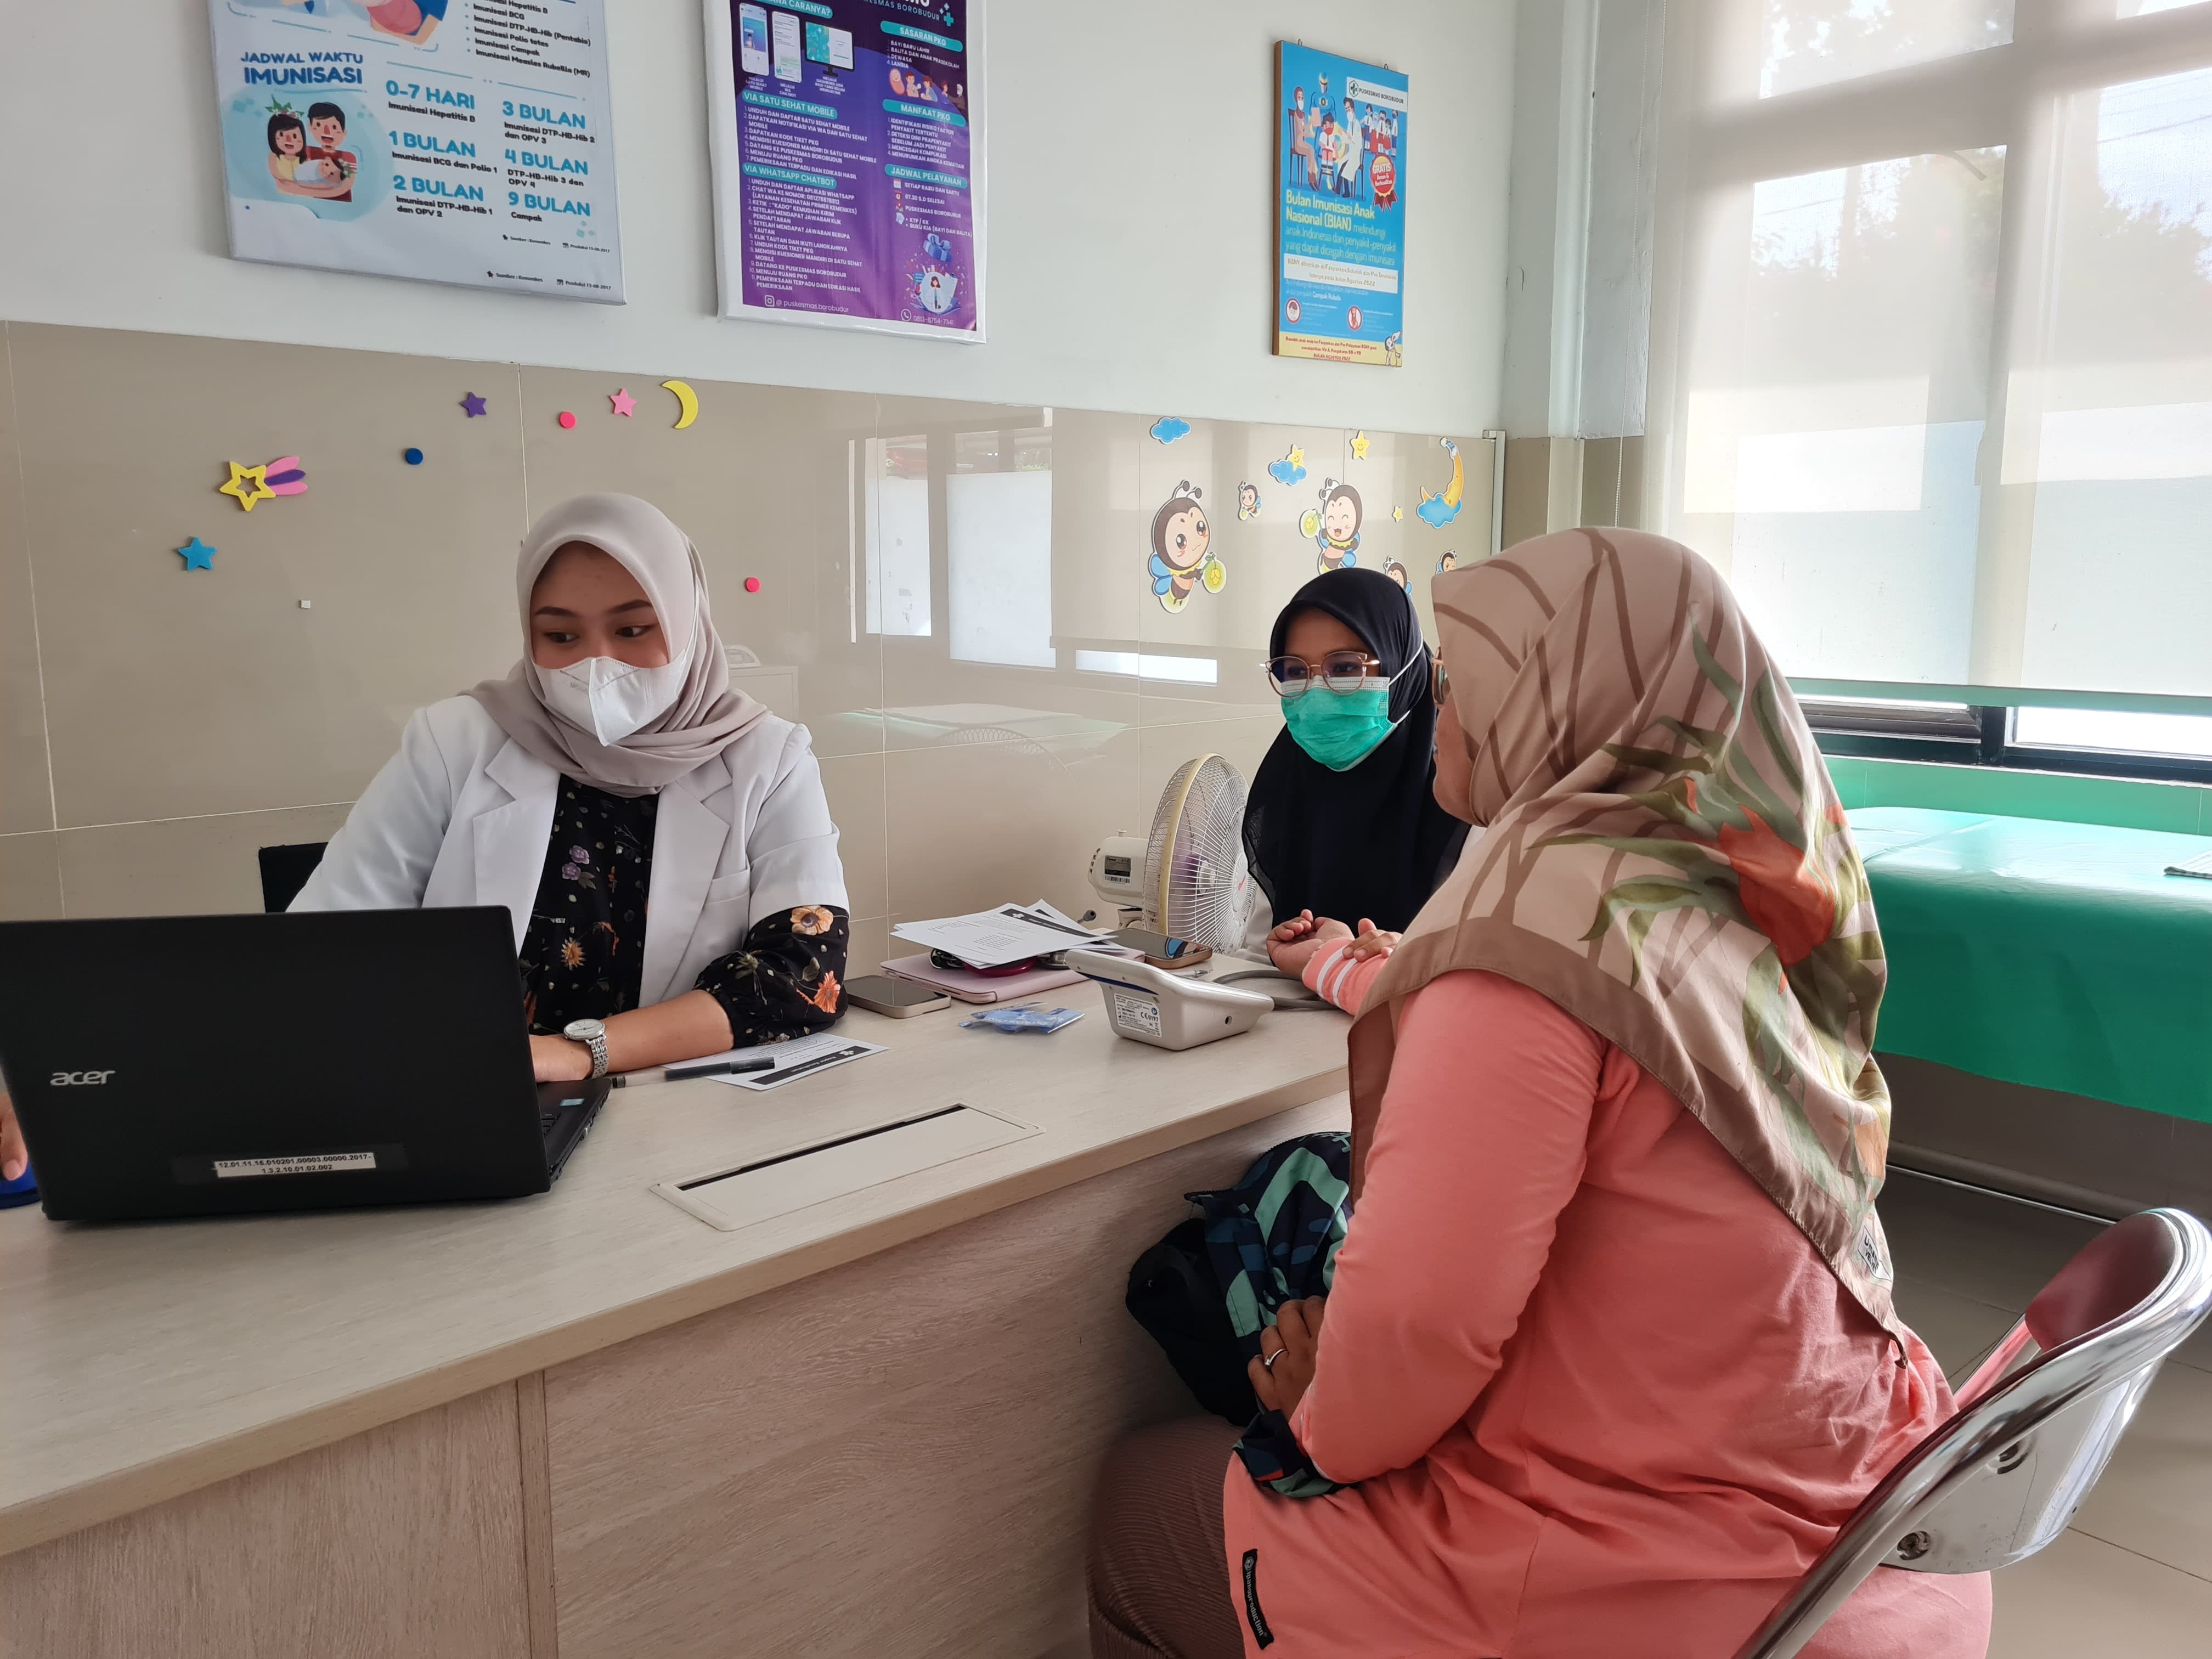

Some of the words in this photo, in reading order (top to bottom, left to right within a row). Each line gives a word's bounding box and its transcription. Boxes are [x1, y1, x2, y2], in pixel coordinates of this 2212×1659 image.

[473, 3, 507, 15] Imunisasi
[509, 11, 524, 20] BCG
[509, 0, 541, 12] Hepatitis
[789, 0, 831, 15] CARANYA?
[897, 3, 940, 21] BOROBUDUR
[474, 15, 507, 27] Imunisasi
[509, 22, 552, 37] DTP-HB-Hib
[554, 32, 591, 46] (Pentabio)
[475, 26, 508, 38] Imunisasi
[510, 33, 528, 43] Polio
[530, 38, 549, 47] tetes
[900, 27, 932, 41] SASARAN
[934, 36, 946, 46] PKG
[475, 38, 509, 50] Imunisasi
[511, 45, 540, 56] Campak
[241, 52, 305, 64] JADWAL
[308, 52, 363, 64] WAKTU
[476, 49, 510, 61] Imunisasi
[512, 56, 541, 67] Measles
[574, 68, 590, 78] (MR)
[244, 66, 363, 85] IMUNISASI
[386, 80, 420, 99] 0-7
[426, 87, 475, 109] HARI
[1359, 88, 1379, 98] PUSKESMAS
[1381, 93, 1403, 104] BOROBUDUR
[388, 101, 427, 115] Imunisasi
[430, 109, 467, 121] Hepatitis
[744, 92, 758, 101] VIA
[759, 95, 780, 106] SATU
[781, 99, 804, 111] SEHAT
[807, 105, 834, 117] MOBILE
[901, 104, 935, 118] MANFAAT
[937, 111, 950, 121] PKG
[503, 100, 514, 116] 3
[520, 103, 585, 129] BULAN
[748, 106, 766, 115] UNDUH
[780, 113, 800, 122] DAFTAR
[832, 123, 849, 131] MOBILE
[504, 121, 540, 134] Imunisasi
[542, 128, 588, 142] DTP-HB-Hib
[505, 131, 520, 140] dan
[522, 134, 539, 143] OPV
[749, 128, 777, 138] DAPATKAN
[389, 131, 398, 145] 1
[403, 132, 476, 157] BULAN
[749, 142, 771, 151] DATANG
[780, 148, 810, 157] PUSKESMAS
[392, 151, 431, 163] Imunisasi
[433, 157, 452, 166] BCG
[471, 163, 492, 172] Polio
[505, 149, 516, 164] 4
[522, 151, 588, 175] BULAN
[1373, 163, 1391, 174] GRATIS
[507, 168, 558, 182] DTP-HB-Hib
[569, 178, 584, 187] dan
[509, 178, 527, 187] OPV
[744, 165, 757, 173] VIA
[759, 167, 799, 180] WHATSAPP
[801, 174, 834, 186] CHATBOT
[891, 167, 921, 178] JADWAL
[923, 172, 961, 185] PELAYANAN
[393, 175, 407, 190] 2
[412, 177, 483, 201] BULAN
[396, 195, 436, 207] Imunisasi
[437, 201, 487, 214] DTP-HB-Hib
[415, 208, 435, 216] OPV
[508, 191, 519, 206] 9
[524, 193, 590, 216] BULAN
[1286, 189, 1311, 207] Bulan
[1313, 195, 1352, 215] Imunisasi
[1353, 202, 1374, 219] Anak
[511, 211, 543, 222] Campak
[1286, 206, 1322, 226] Nasional
[1324, 213, 1351, 232] (BIAN)
[49, 1070, 116, 1086] acer
